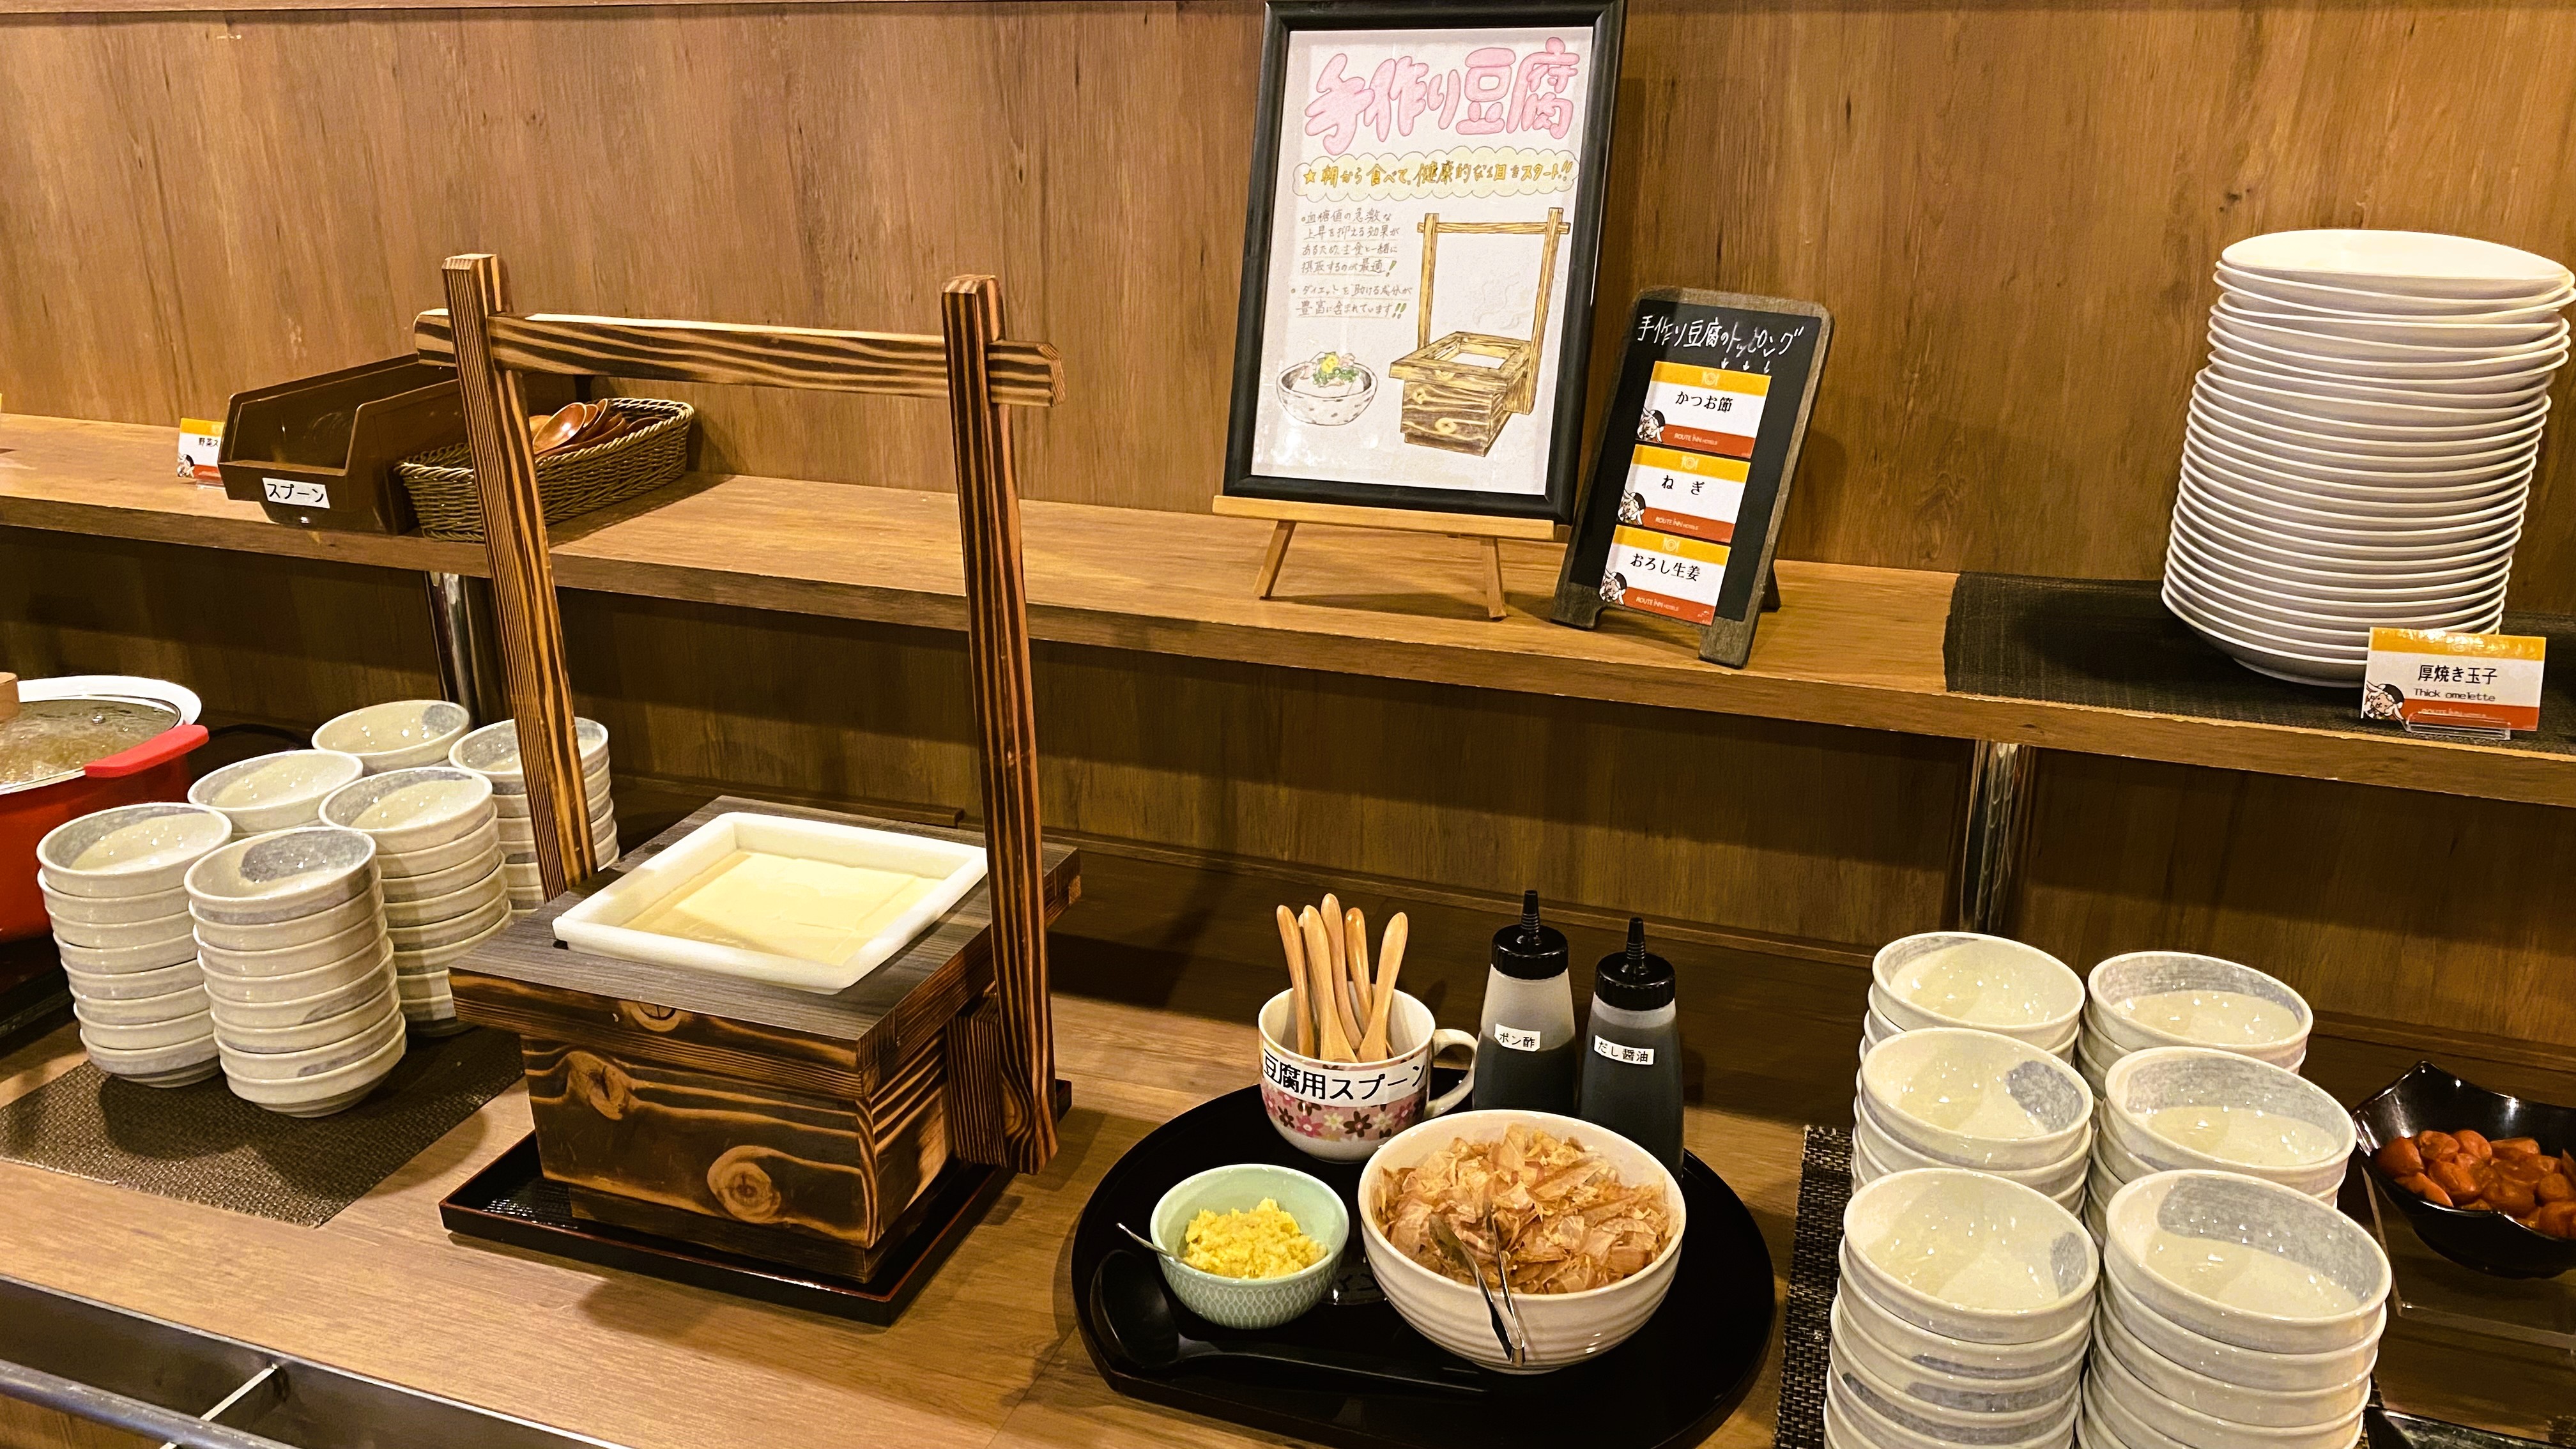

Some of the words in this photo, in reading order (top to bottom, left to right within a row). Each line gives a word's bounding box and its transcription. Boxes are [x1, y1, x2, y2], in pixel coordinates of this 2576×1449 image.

[1305, 36, 1580, 155] 手作り豆腐
[1637, 315, 1804, 357] 手作り豆腐のトッピング
[1675, 391, 1733, 413] かつお節
[267, 483, 324, 502] スプーン
[1661, 475, 1705, 495] ねぎ
[1630, 553, 1700, 581] おろし生姜
[2418, 664, 2497, 685] 厚焼き玉子
[2414, 687, 2441, 698] Thick
[2446, 688, 2496, 702] omelette
[1499, 1032, 1536, 1048] ポン酢
[1598, 1040, 1648, 1062] だし醤油
[1264, 1049, 1425, 1100] 豆腐用スプーン
